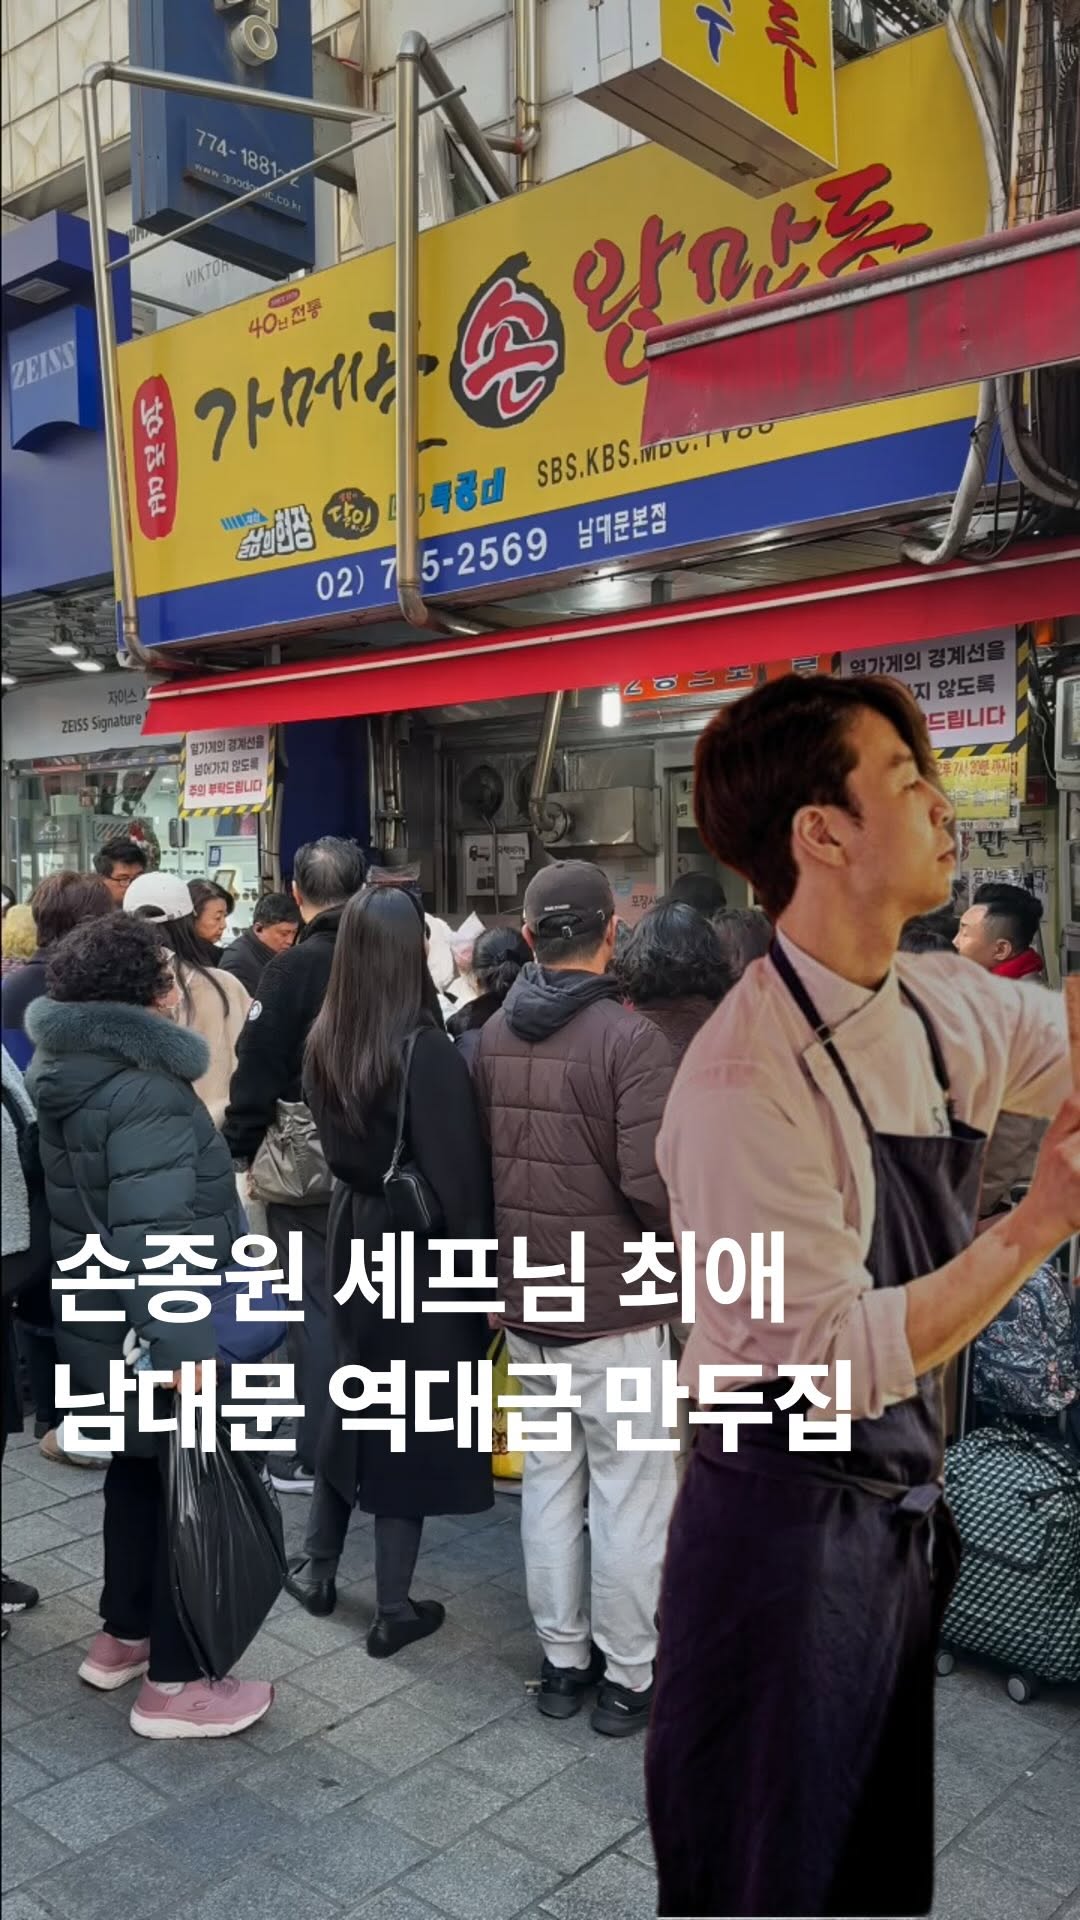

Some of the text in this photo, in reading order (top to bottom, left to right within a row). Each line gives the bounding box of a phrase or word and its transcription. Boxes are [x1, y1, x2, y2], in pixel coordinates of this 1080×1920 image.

[291, 298, 323, 325] 전통
[460, 274, 560, 421] 손
[11, 340, 76, 391] ZEISS
[140, 395, 167, 518] 남대문
[316, 502, 667, 600] 02) 75-2569 남대문본점
[927, 640, 1006, 669] 경계선을
[107, 688, 138, 708] 자이스
[937, 674, 996, 699] 않도록
[61, 712, 142, 734] ZEISS Signature
[920, 705, 1006, 732] 드립니다
[208, 779, 263, 796] 부탁드립니다
